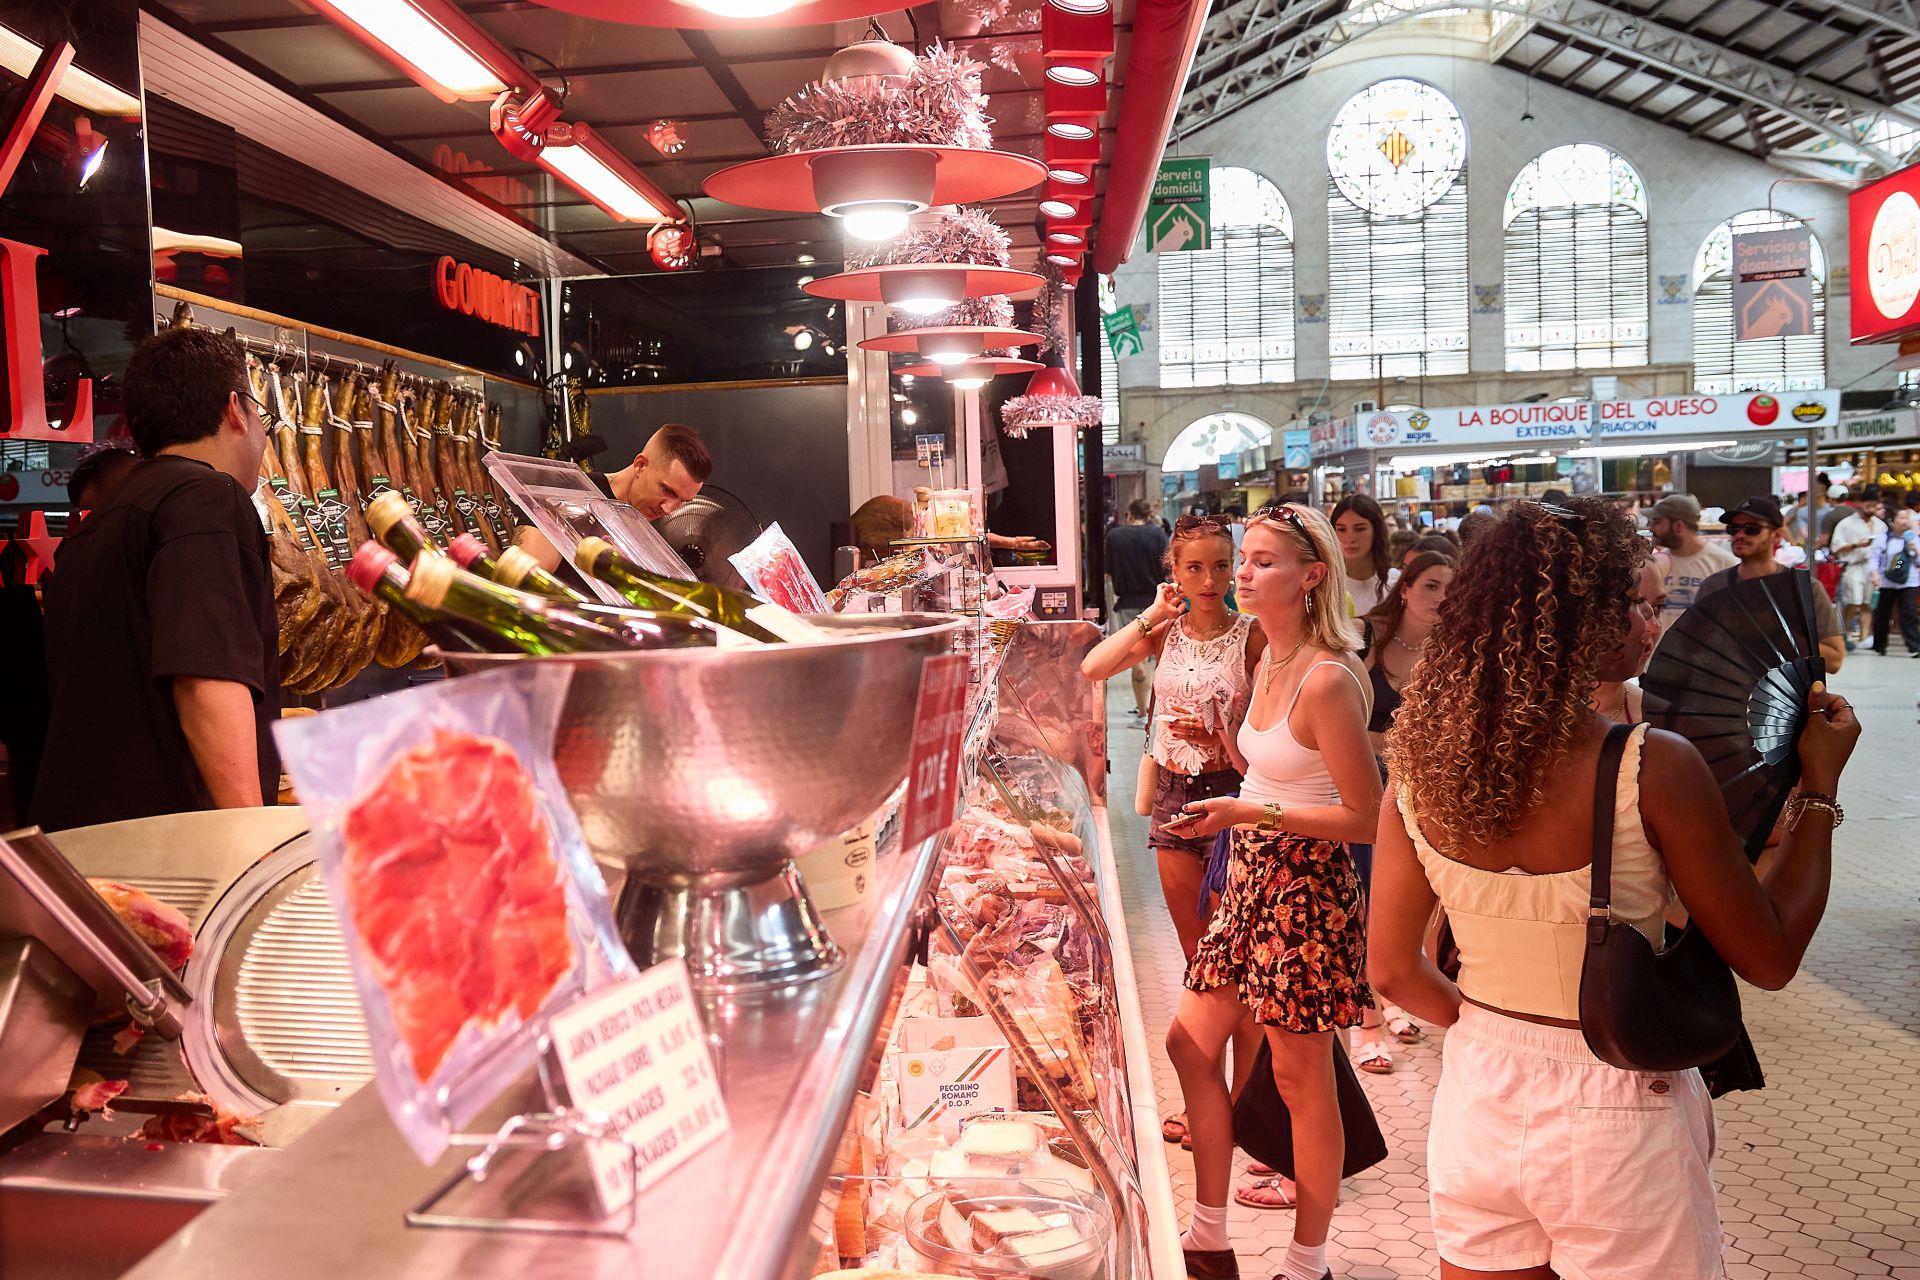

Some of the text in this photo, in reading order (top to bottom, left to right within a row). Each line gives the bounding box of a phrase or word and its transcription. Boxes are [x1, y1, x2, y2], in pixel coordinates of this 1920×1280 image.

[1156, 168, 1202, 182] Servei a
[1154, 181, 1202, 195] domicili
[1737, 239, 1808, 256] Servicio a
[1740, 254, 1807, 272] domicilio
[433, 255, 541, 337] GOURMET
[1458, 398, 1718, 427] LA BOUTIQUE DEL QUESO
[1517, 420, 1657, 438] EXTENSA VRIACION
[939, 1083, 980, 1092] PECORINO
[941, 1091, 979, 1100] ROMANO
